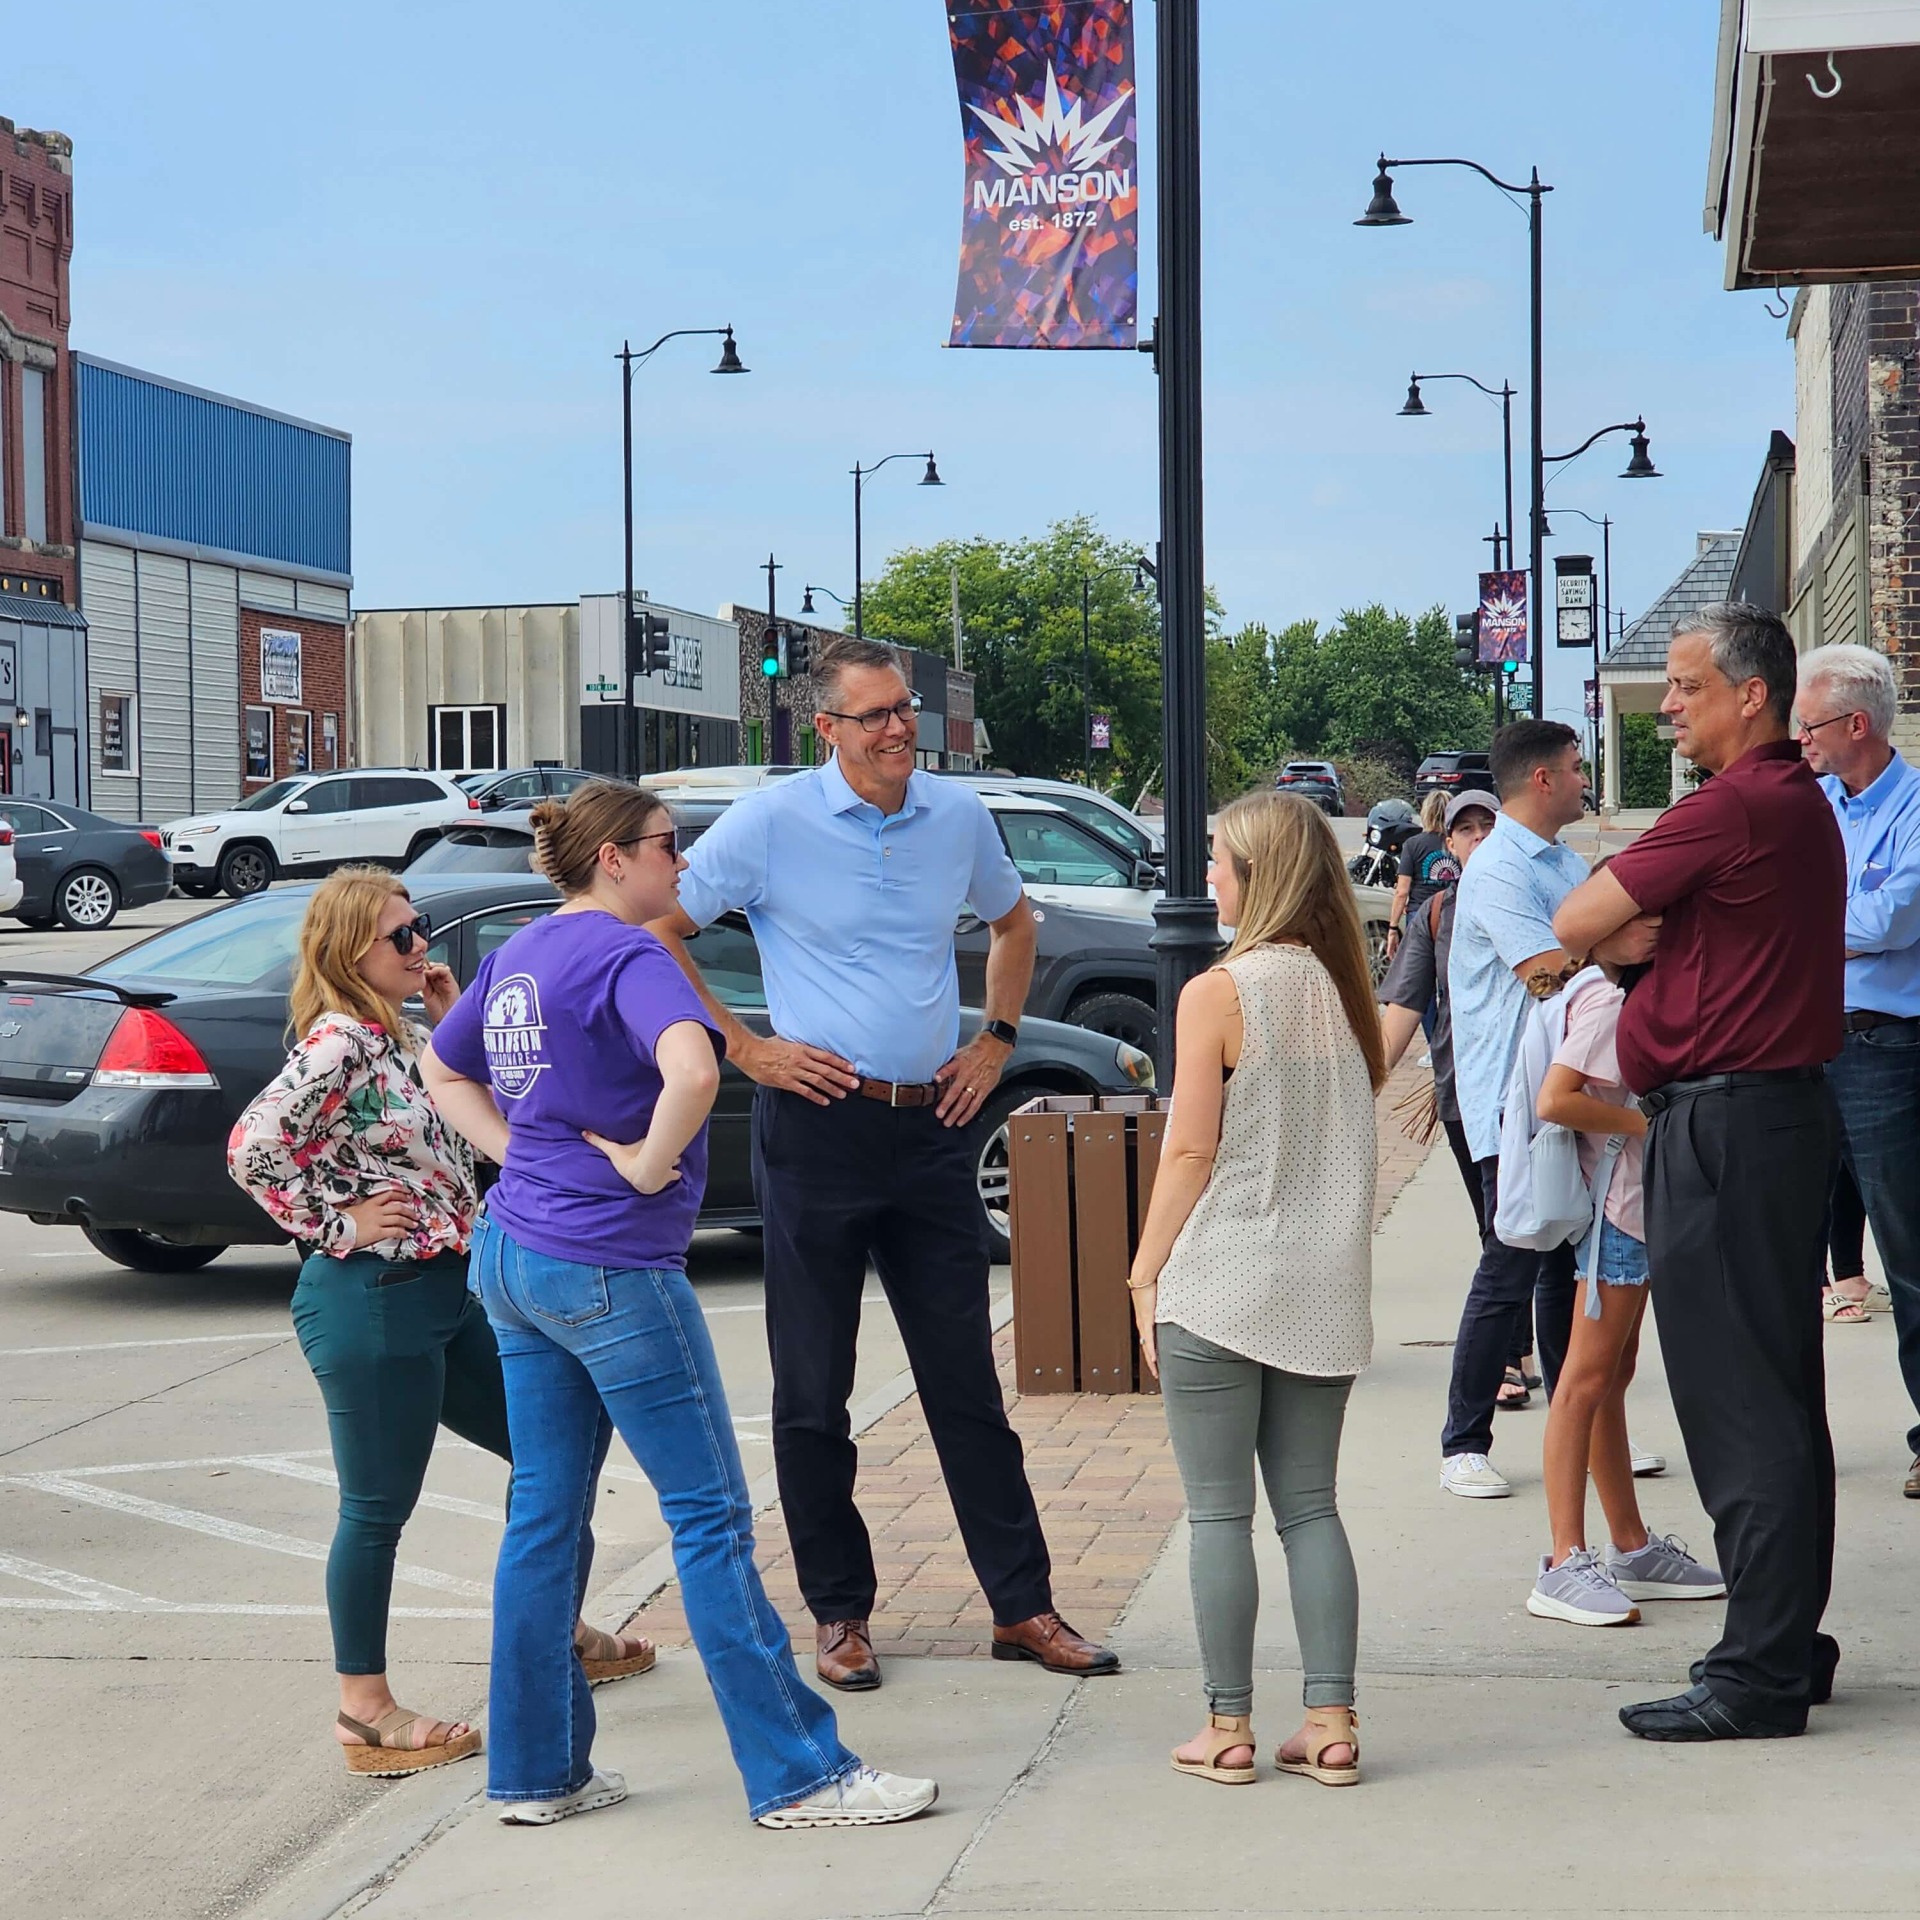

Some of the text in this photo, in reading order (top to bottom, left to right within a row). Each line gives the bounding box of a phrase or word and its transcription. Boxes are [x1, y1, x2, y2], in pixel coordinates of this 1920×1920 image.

[972, 168, 1130, 209] MANSON
[1008, 211, 1097, 232] est. 1872
[1559, 579, 1588, 587] SECURITY
[1561, 588, 1587, 596] SAVINGS
[1565, 596, 1583, 604] BANK
[1482, 617, 1527, 628] MANSON
[1508, 692, 1528, 701] POLICE
